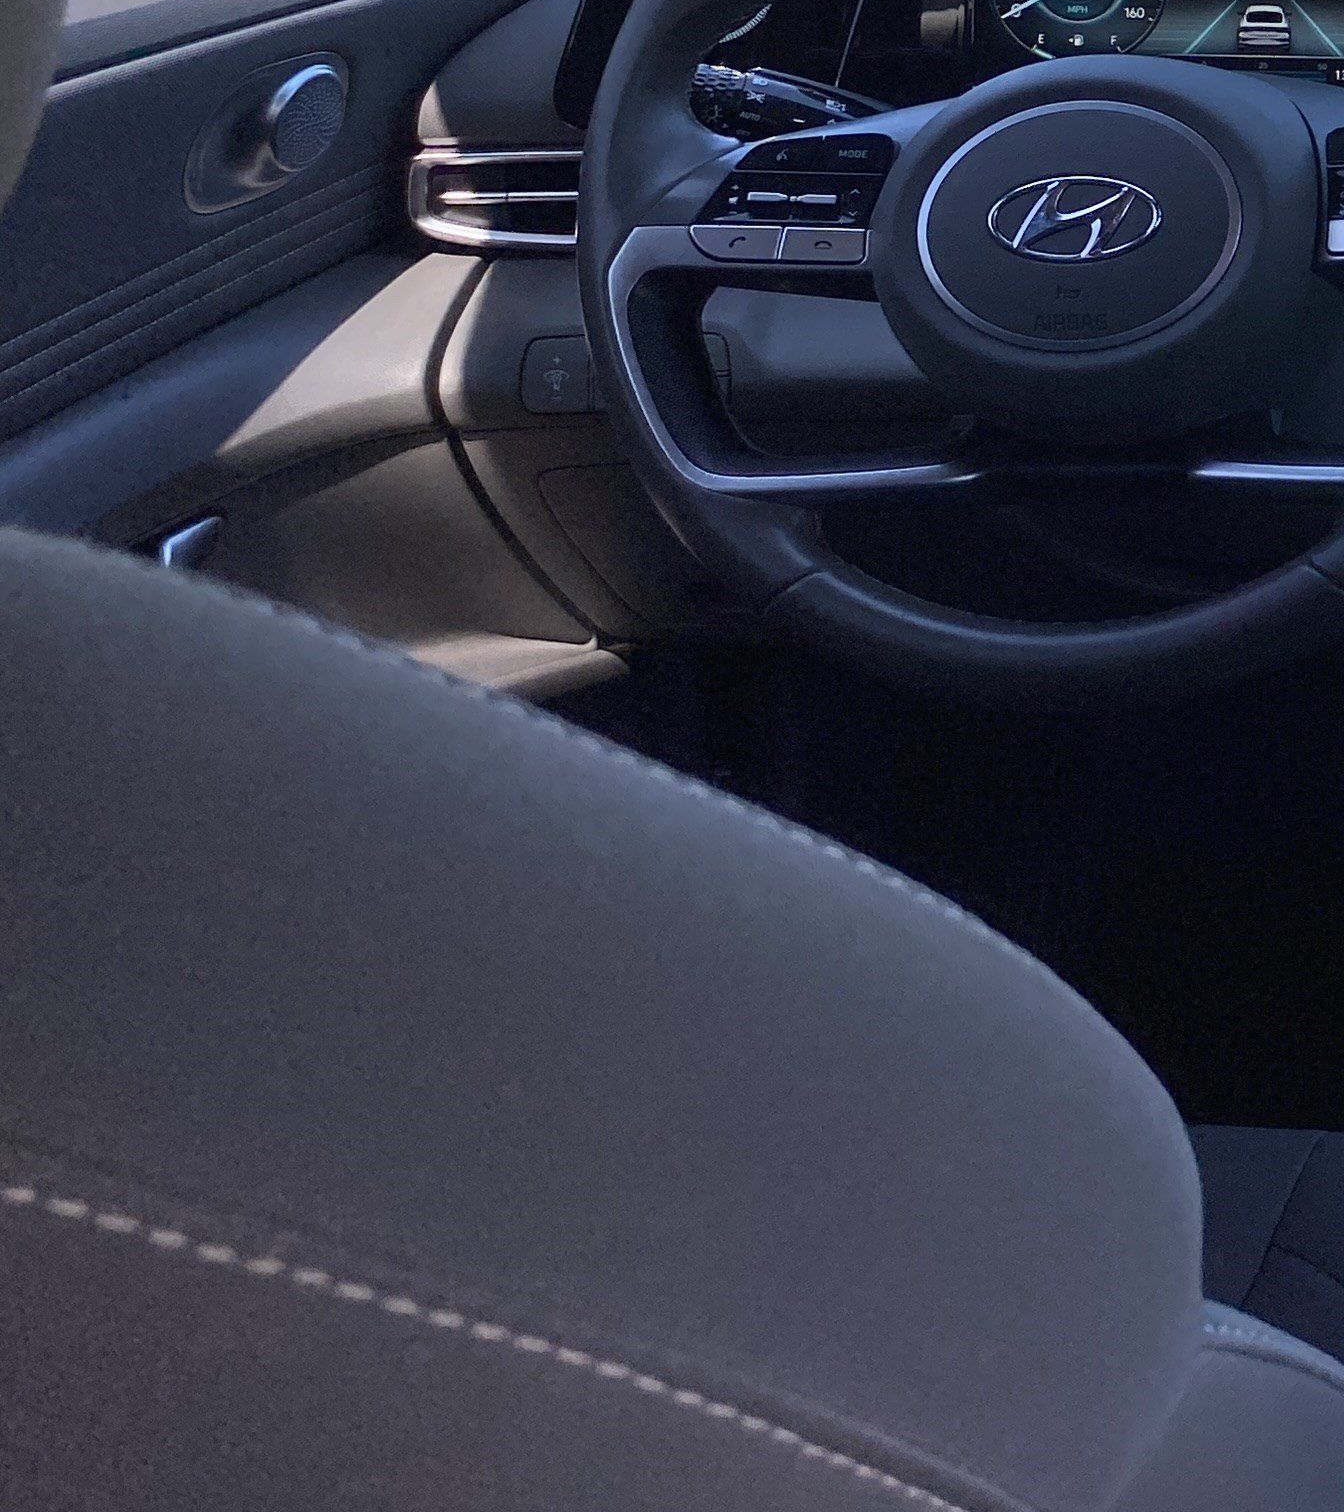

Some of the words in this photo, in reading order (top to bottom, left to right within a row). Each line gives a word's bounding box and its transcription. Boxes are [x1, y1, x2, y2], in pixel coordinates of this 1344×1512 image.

[1067, 5, 1088, 14] MPH
[1125, 7, 1145, 19] 160
[1038, 34, 1045, 44] E
[1110, 35, 1118, 45] F
[739, 111, 761, 122] AUTO
[838, 149, 868, 159] MODE
[1033, 313, 1109, 332] AIRBAG
